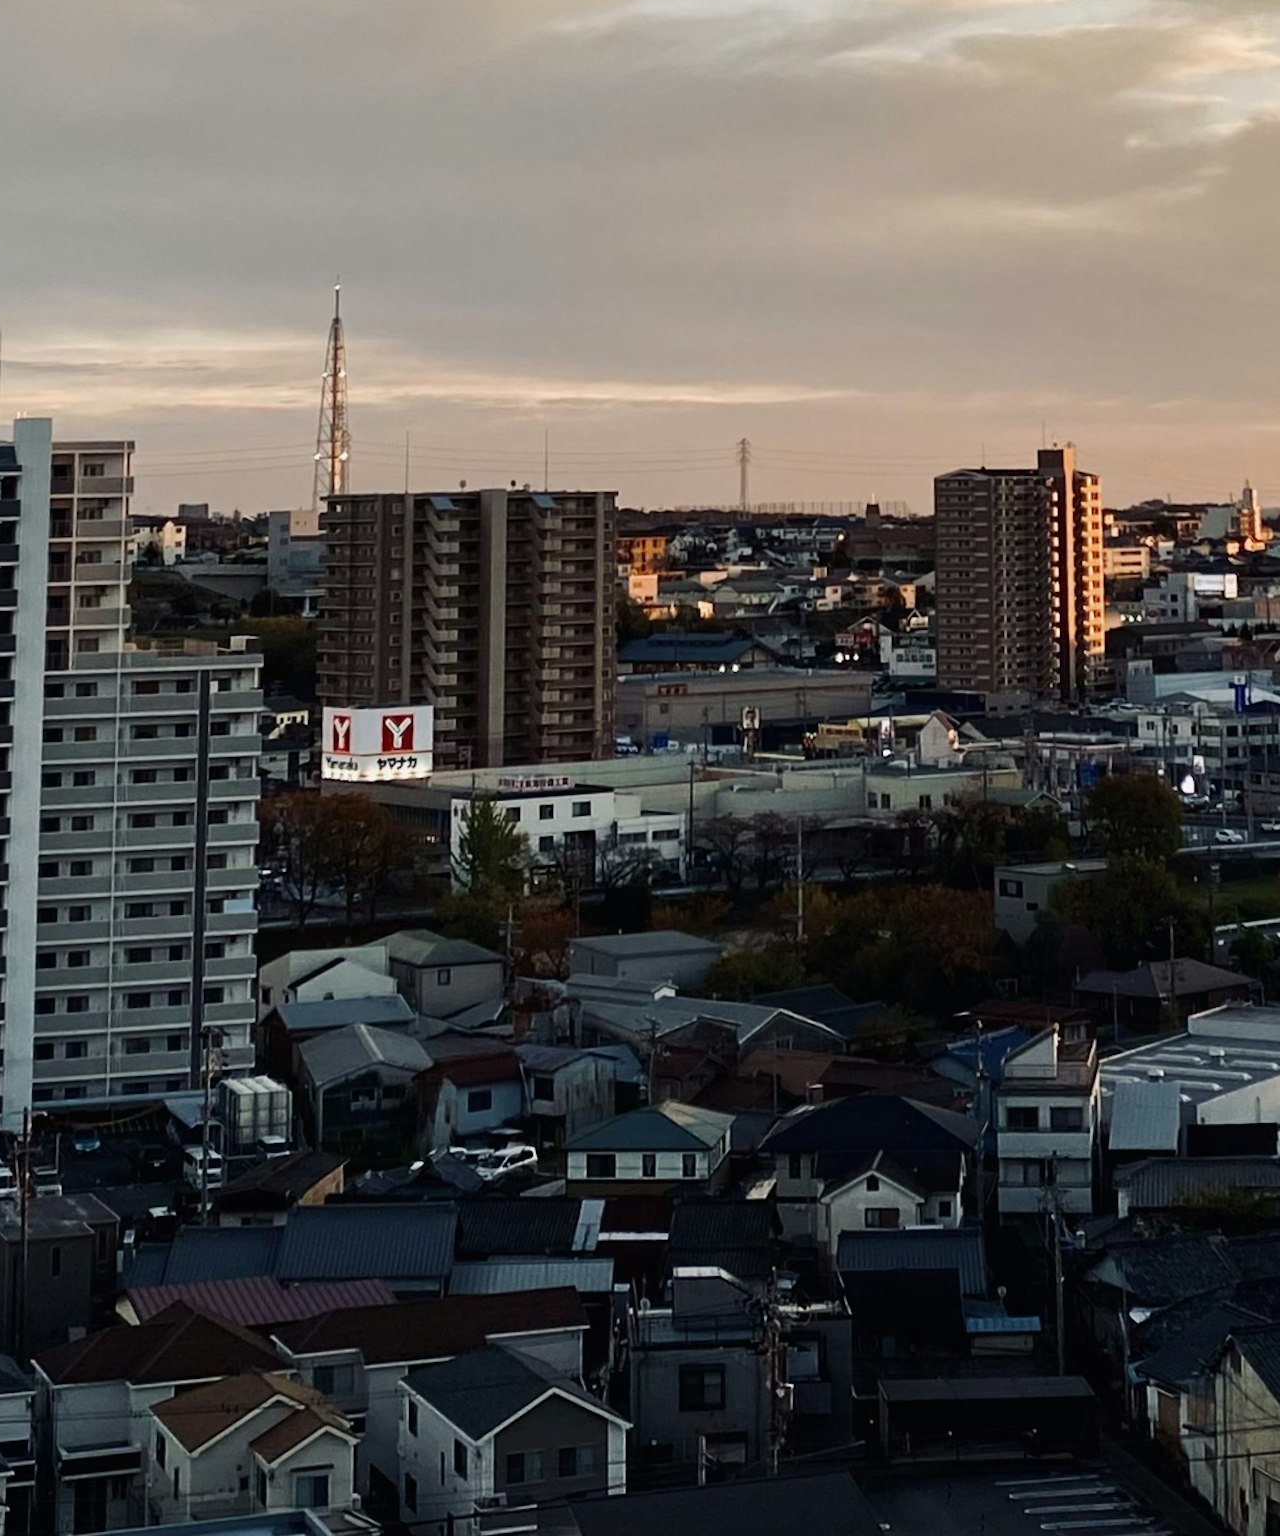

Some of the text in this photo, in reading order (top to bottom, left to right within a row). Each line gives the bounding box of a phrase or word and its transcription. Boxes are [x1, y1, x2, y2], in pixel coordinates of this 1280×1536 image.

[334, 718, 349, 749] Y
[385, 717, 411, 748] Y
[377, 756, 417, 770] ヤマナカ
